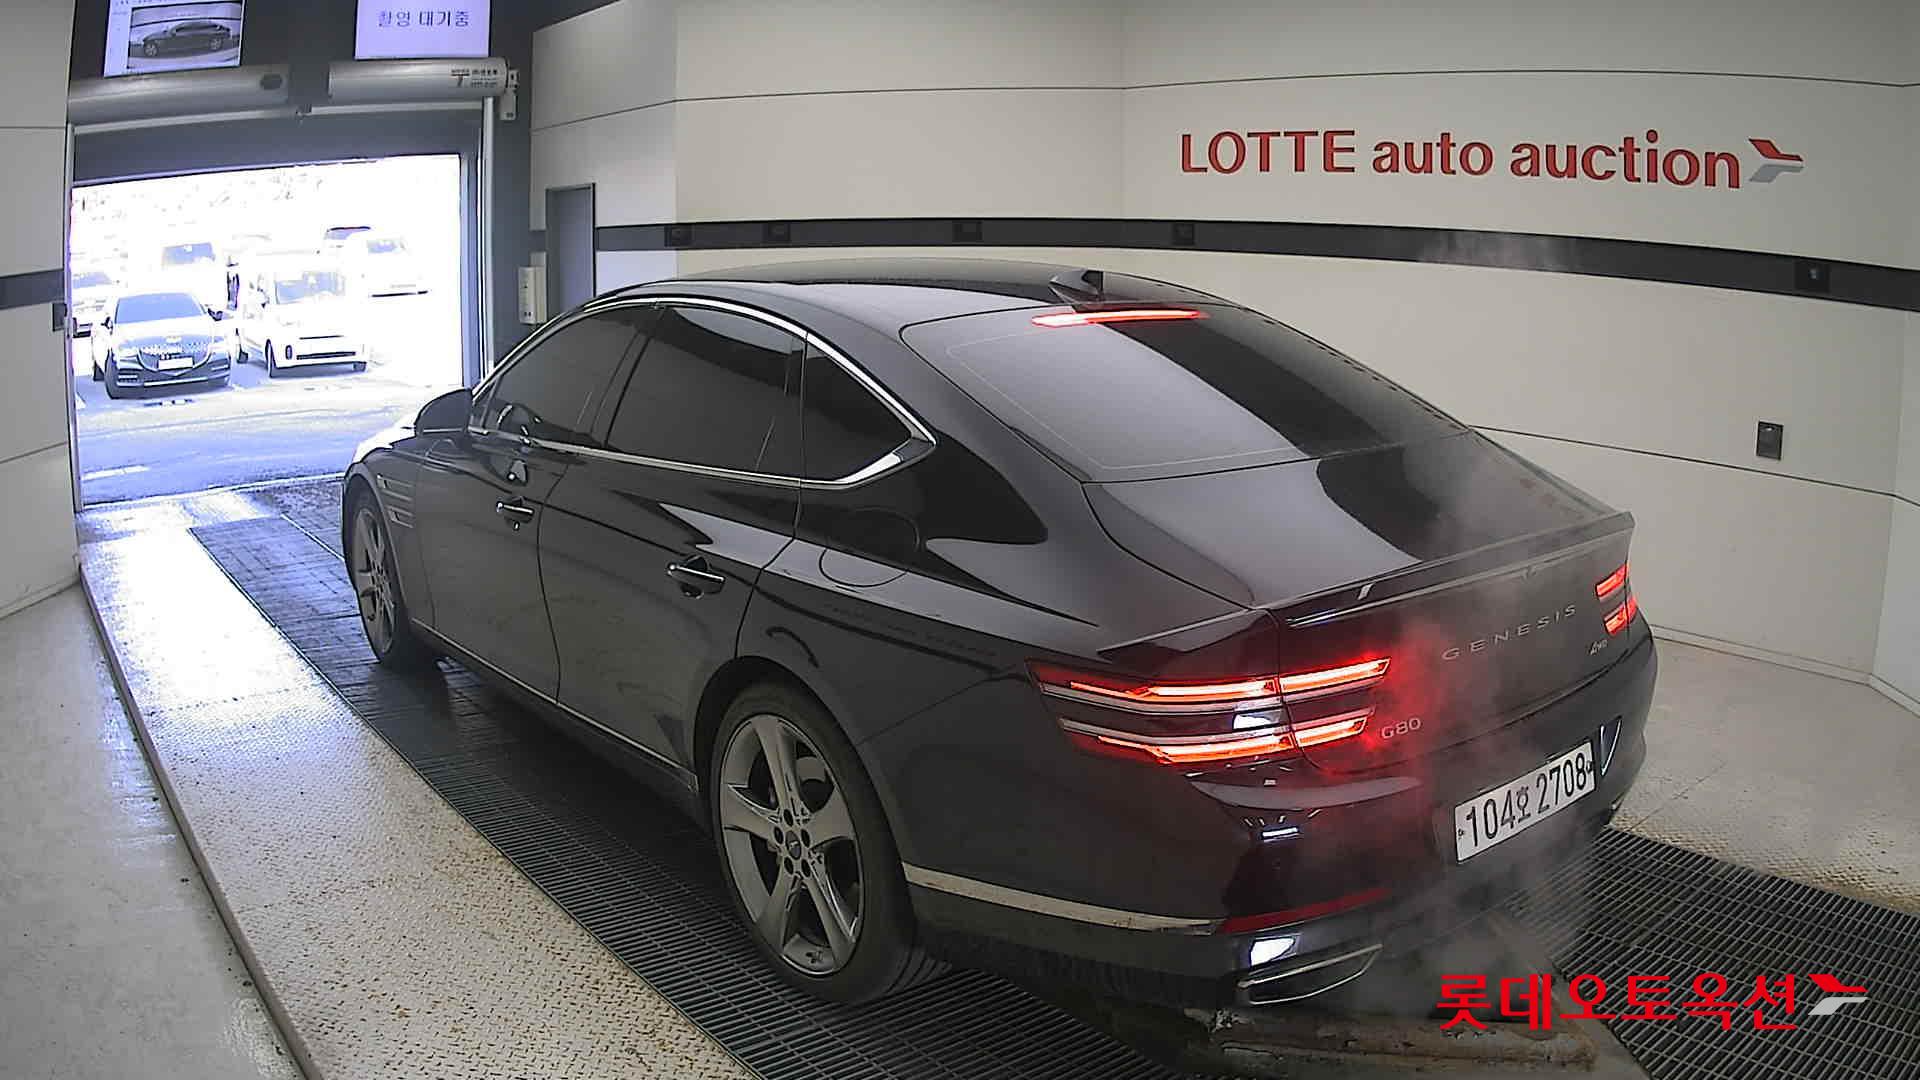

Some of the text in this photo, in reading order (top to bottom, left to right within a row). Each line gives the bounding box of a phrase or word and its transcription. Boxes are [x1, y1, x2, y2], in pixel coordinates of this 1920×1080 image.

[1181, 129, 1740, 189] LOTTE auto auction
[1441, 604, 1577, 661] GENESIS
[1381, 717, 1422, 740] G80
[1536, 752, 1587, 814] 2708
